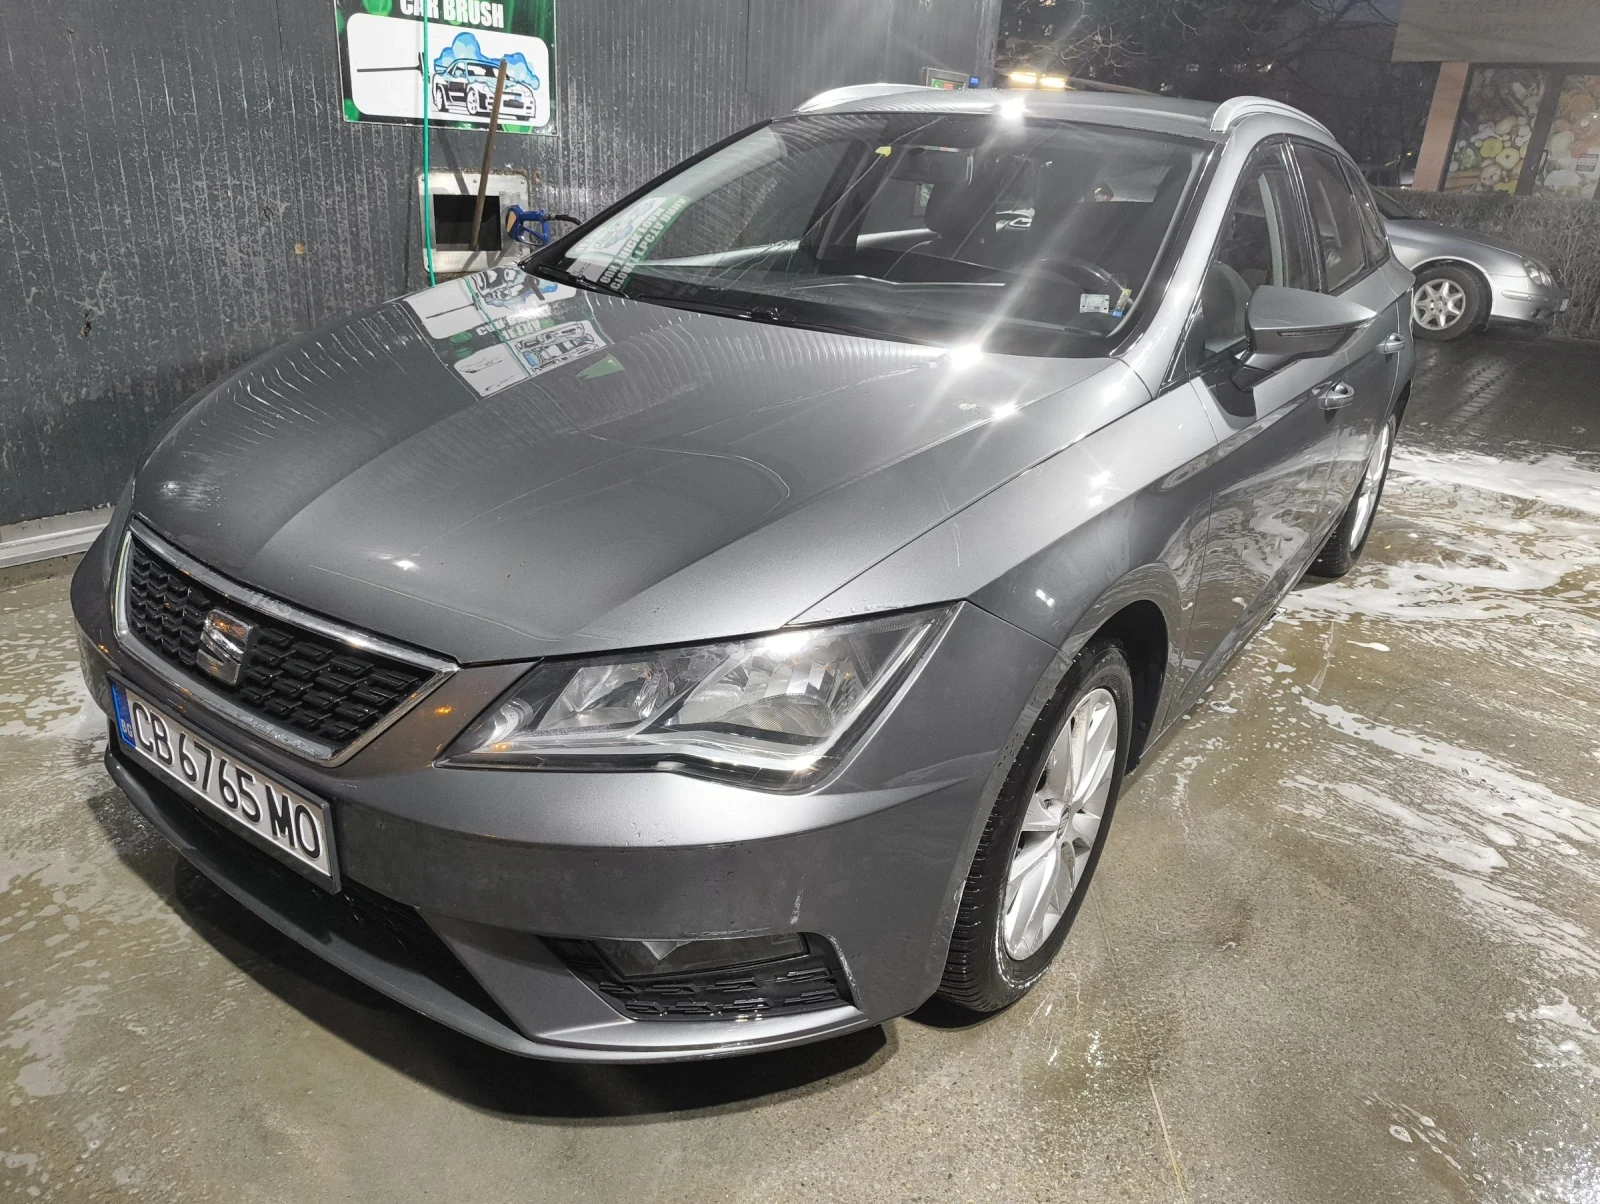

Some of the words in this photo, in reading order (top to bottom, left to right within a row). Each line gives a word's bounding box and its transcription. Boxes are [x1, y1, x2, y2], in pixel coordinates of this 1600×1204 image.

[399, 0, 439, 19] CAR
[443, 0, 504, 29] BRUSH
[120, 718, 134, 738] BG
[132, 701, 174, 767] CB
[179, 731, 263, 825] 6765
[265, 783, 322, 860] MO
